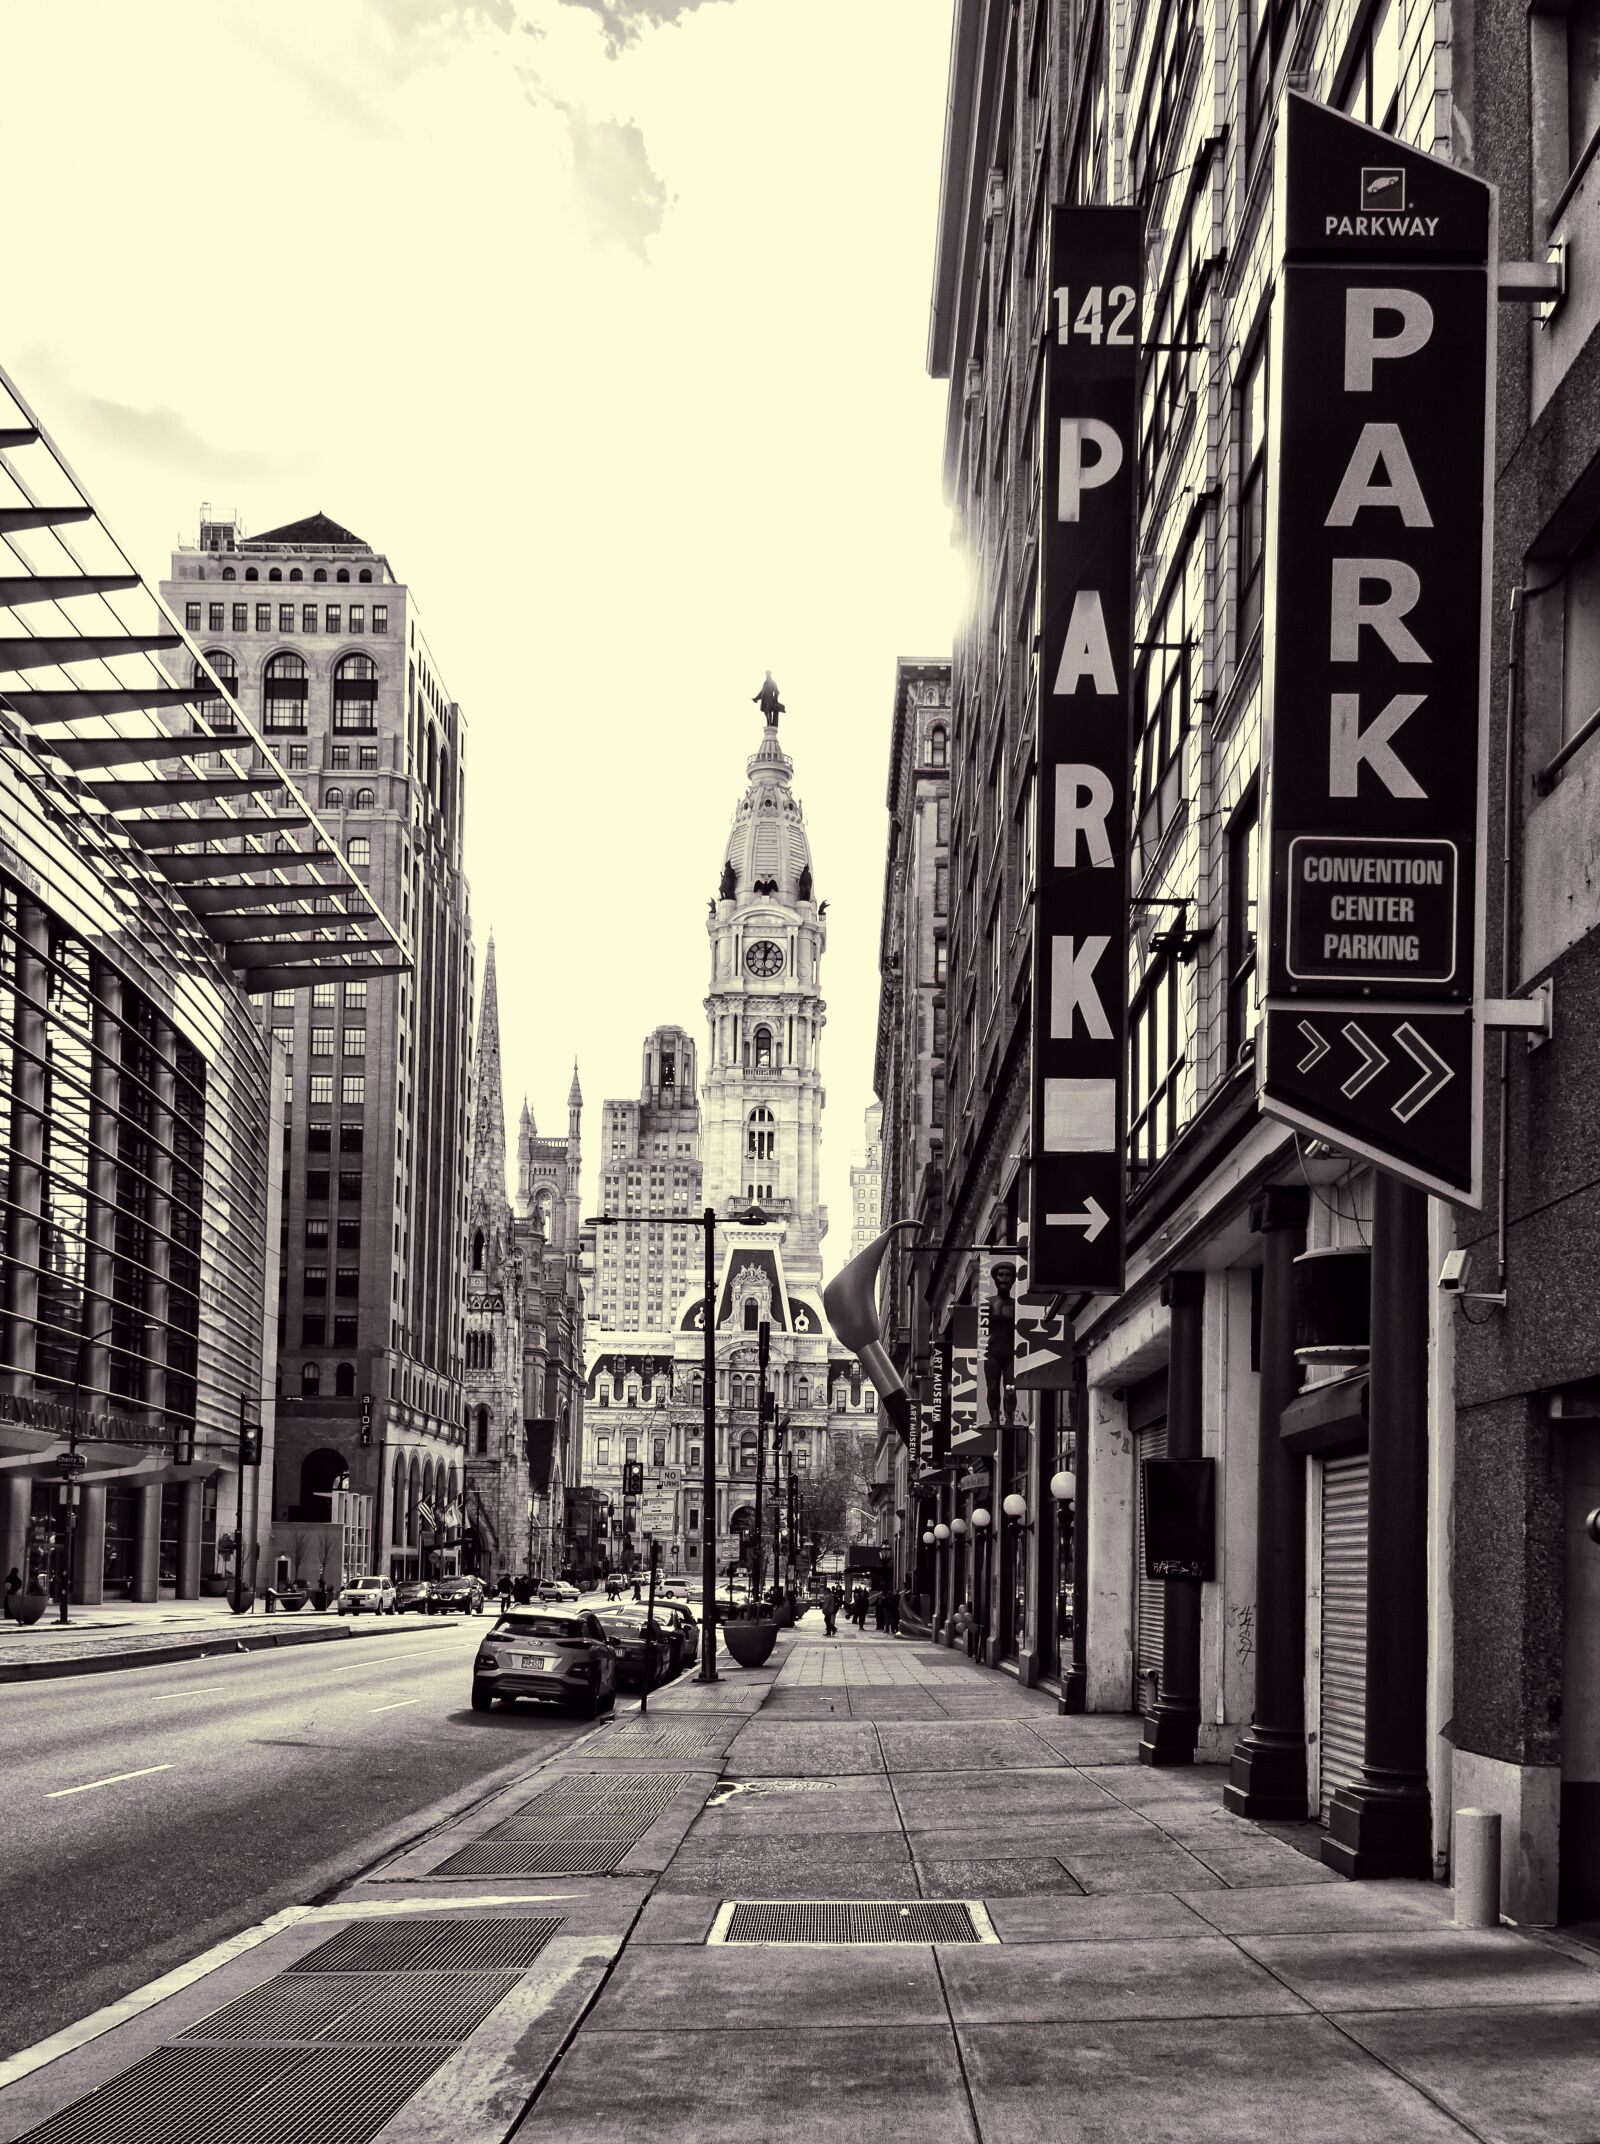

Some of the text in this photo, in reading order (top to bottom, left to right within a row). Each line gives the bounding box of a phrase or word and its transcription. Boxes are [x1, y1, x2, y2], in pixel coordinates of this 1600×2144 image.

[1325, 216, 1440, 236] PARKWAY
[1053, 285, 1137, 345] 142
[1323, 288, 1434, 799] PARK
[1050, 417, 1124, 1040] PARK
[1303, 856, 1443, 885] CONVENTION
[1330, 895, 1415, 922] CENTER
[1323, 934, 1420, 961] PARKING
[978, 1255, 991, 1361] ART MUSEUM
[932, 1349, 943, 1422] ART MUSEUM
[909, 1404, 917, 1461] ART MUSEUM
[57, 1456, 77, 1464] Cherry
[664, 1471, 676, 1479] NO
